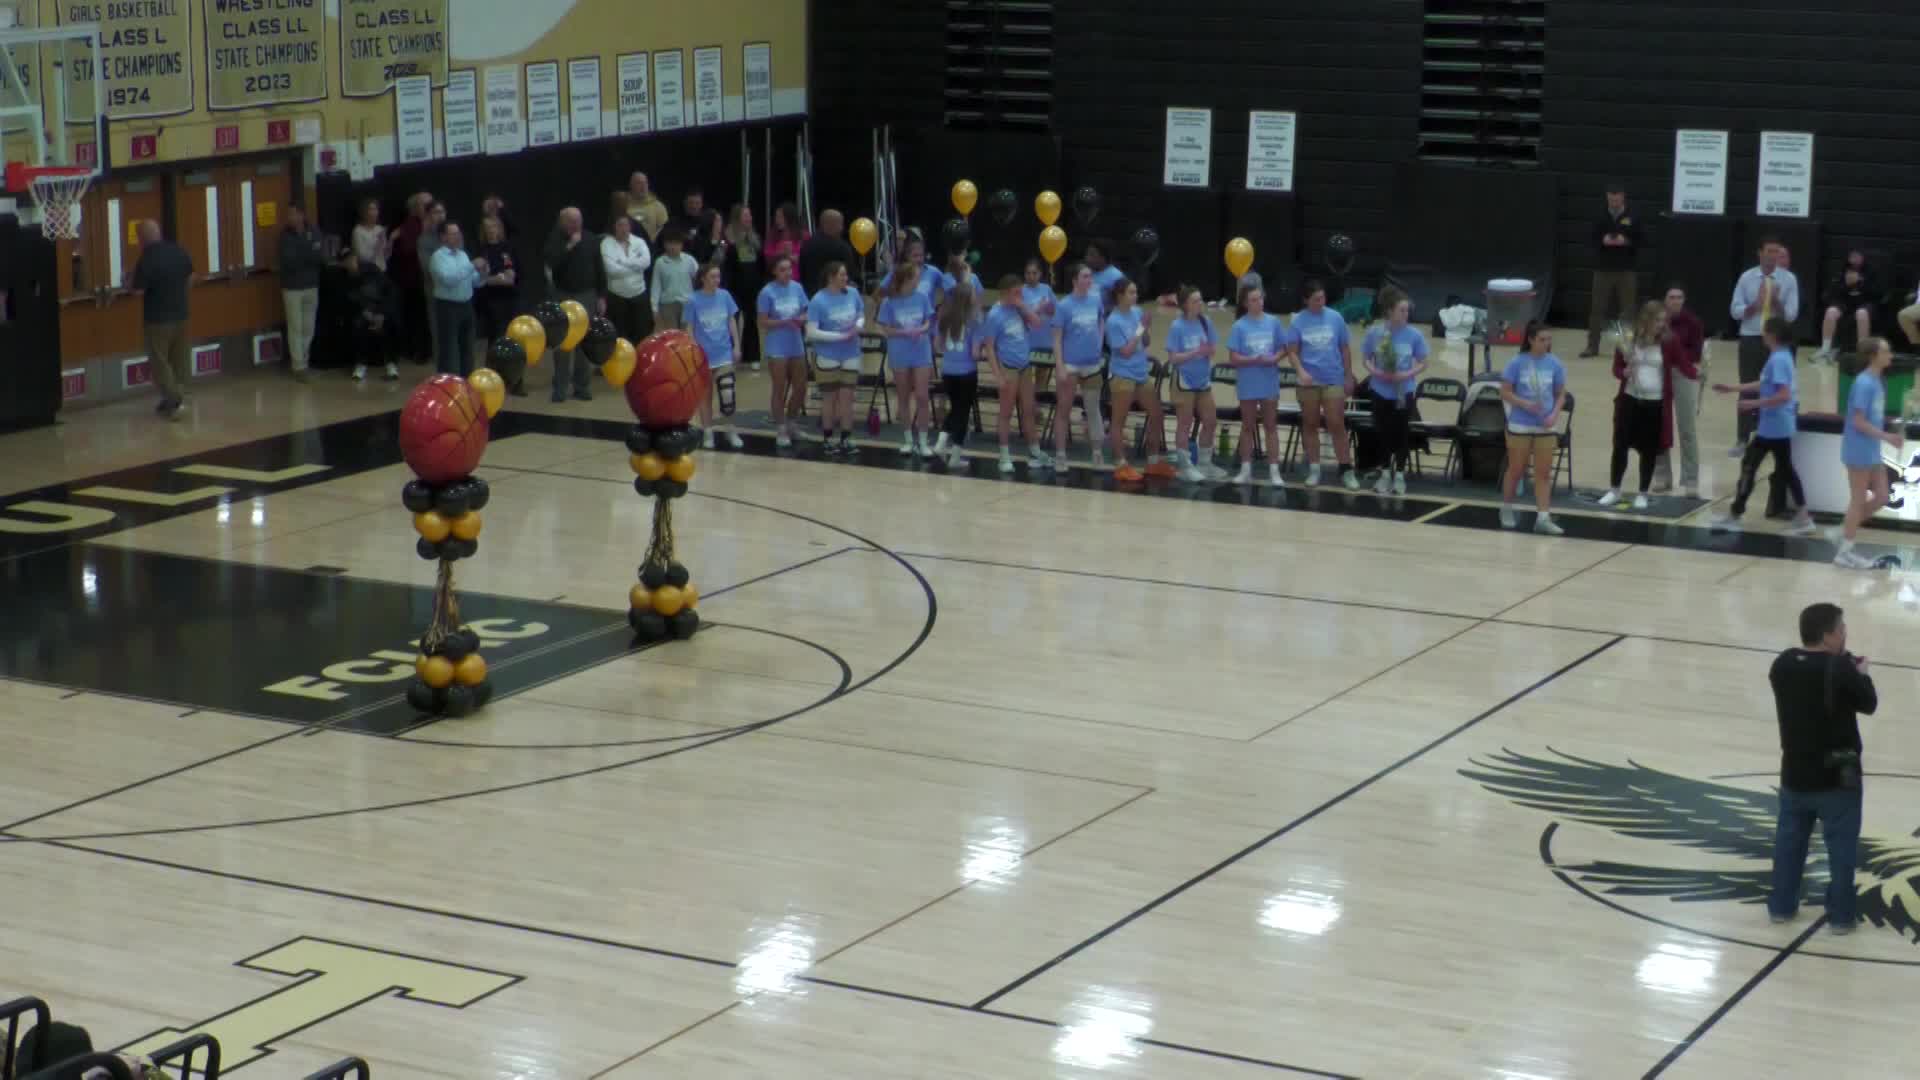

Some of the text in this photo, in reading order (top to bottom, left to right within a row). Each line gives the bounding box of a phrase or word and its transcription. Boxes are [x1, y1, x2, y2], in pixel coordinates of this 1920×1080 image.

[70, 0, 177, 22] GIRLS BASKETBALL
[354, 8, 436, 28] CLASS LL
[155, 27, 168, 44] L
[223, 17, 310, 39] CLASS LL
[215, 41, 318, 70] STATE CHAMPIONS
[351, 37, 384, 59] STATE
[73, 51, 182, 81] STAE CHAMPIONS
[107, 87, 151, 106] 1974
